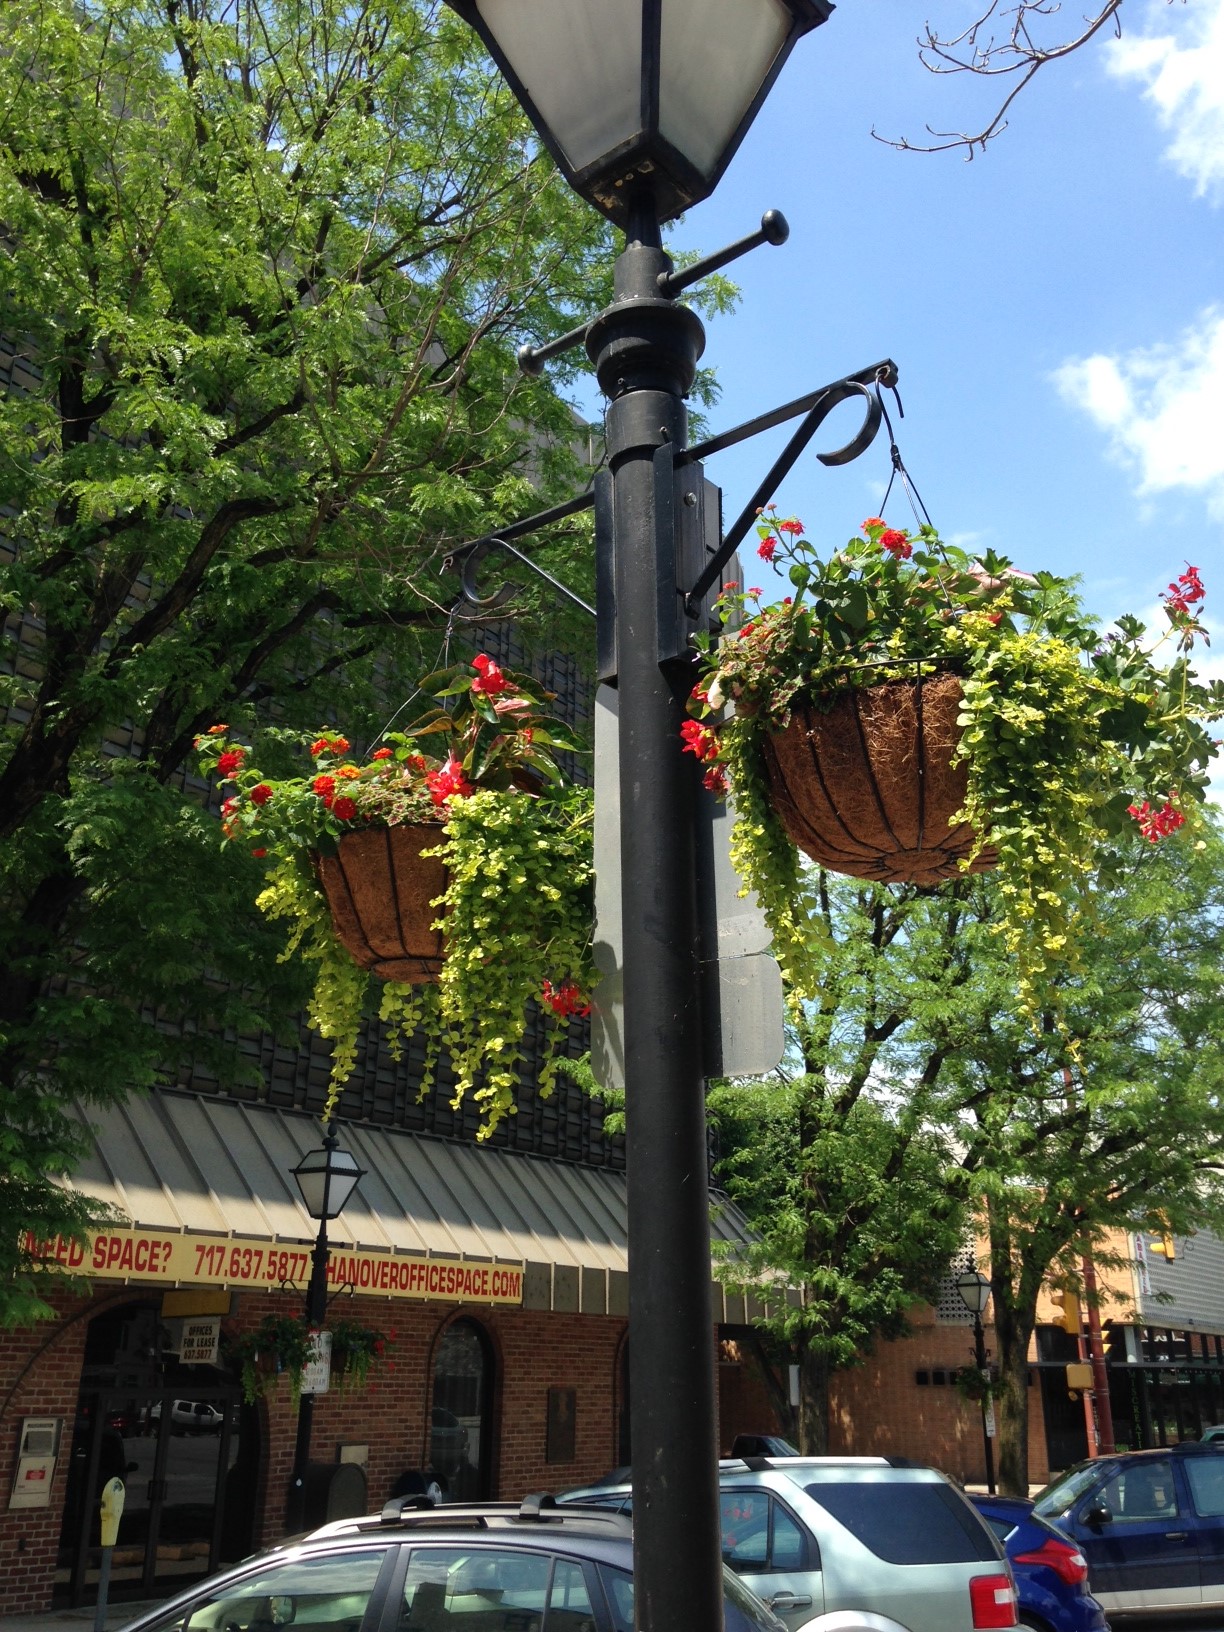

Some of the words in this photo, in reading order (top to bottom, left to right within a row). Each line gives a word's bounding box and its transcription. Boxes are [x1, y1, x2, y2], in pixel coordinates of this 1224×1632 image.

[93, 1235, 172, 1273] SPACE?
[195, 1245, 308, 1282] 717.637.5877
[326, 1256, 520, 1297] HANOVEROFFICESPACE.COM
[189, 1325, 213, 1336] OFFICES
[184, 1337, 195, 1348] FOR
[196, 1337, 216, 1347] LEASE
